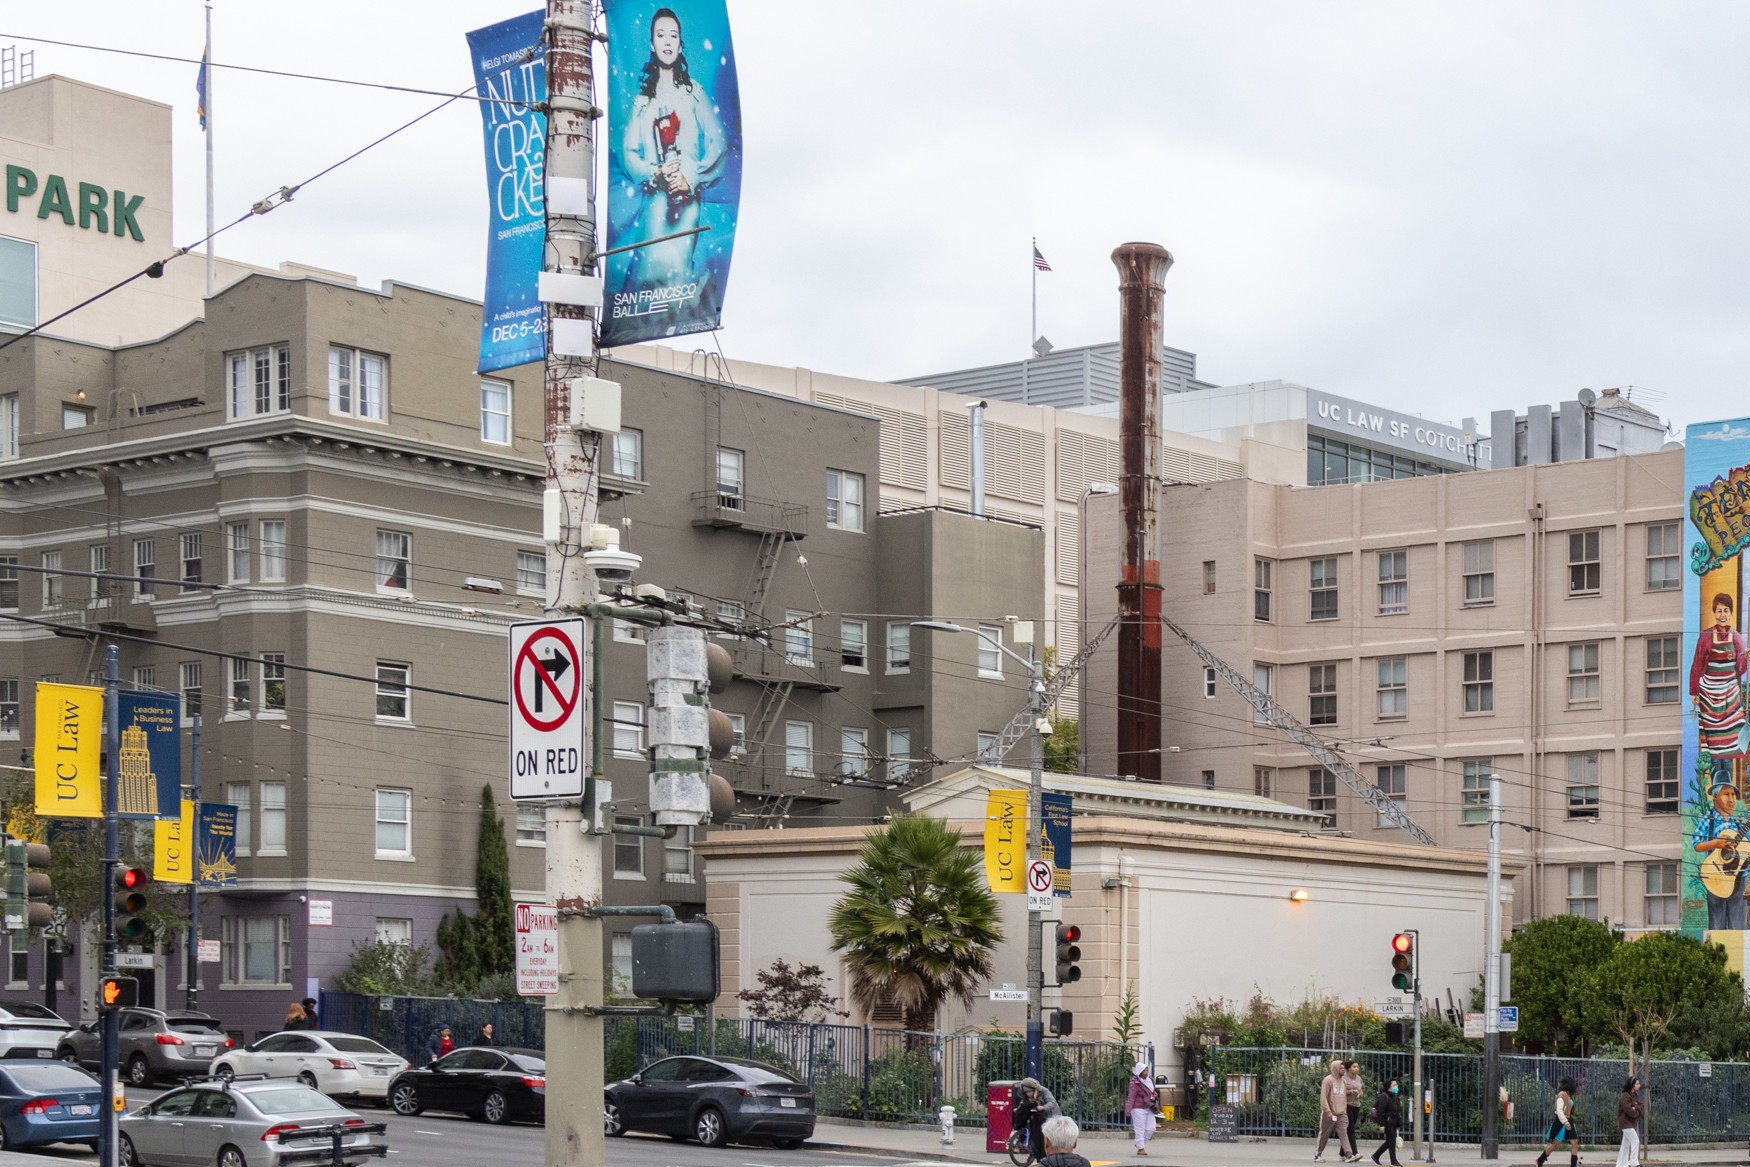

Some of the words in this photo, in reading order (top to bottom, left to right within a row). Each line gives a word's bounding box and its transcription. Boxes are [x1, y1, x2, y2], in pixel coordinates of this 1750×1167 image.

[482, 56, 501, 70] HELGI
[501, 45, 543, 64] TOMASN'S
[485, 57, 545, 125] NUT
[494, 114, 545, 172] CRA
[497, 156, 545, 221] CKE
[6, 164, 145, 242] PARK
[498, 228, 511, 240] SAN
[613, 292, 637, 306] SAN
[638, 283, 697, 303] FRANCISCO
[516, 305, 542, 317] imaginatio
[612, 296, 694, 318] BALLET
[492, 323, 518, 343] DEC
[1317, 401, 1341, 421] UC
[1347, 408, 1384, 433] LAW
[1389, 420, 1409, 439] SF
[133, 705, 164, 714] Leaders
[139, 714, 173, 723] Business
[56, 699, 80, 754] Law
[156, 724, 173, 732] Law
[516, 750, 538, 777] ON
[546, 747, 578, 775] RED
[56, 763, 79, 802] UC
[168, 822, 181, 841] La
[997, 801, 1015, 845] Law
[167, 847, 180, 872] UC
[997, 851, 1014, 883] UC
[1029, 896, 1037, 905] ON
[1039, 896, 1051, 906] RED
[44, 923, 65, 935] 20
[517, 907, 529, 931] NO
[530, 913, 557, 931] PARKING
[124, 955, 143, 965] Larkin
[521, 980, 536, 989] STREET
[536, 980, 557, 989] SWEEPING
[994, 991, 1025, 1000] McAllister
[1211, 1106, 1233, 1114] OPEN
